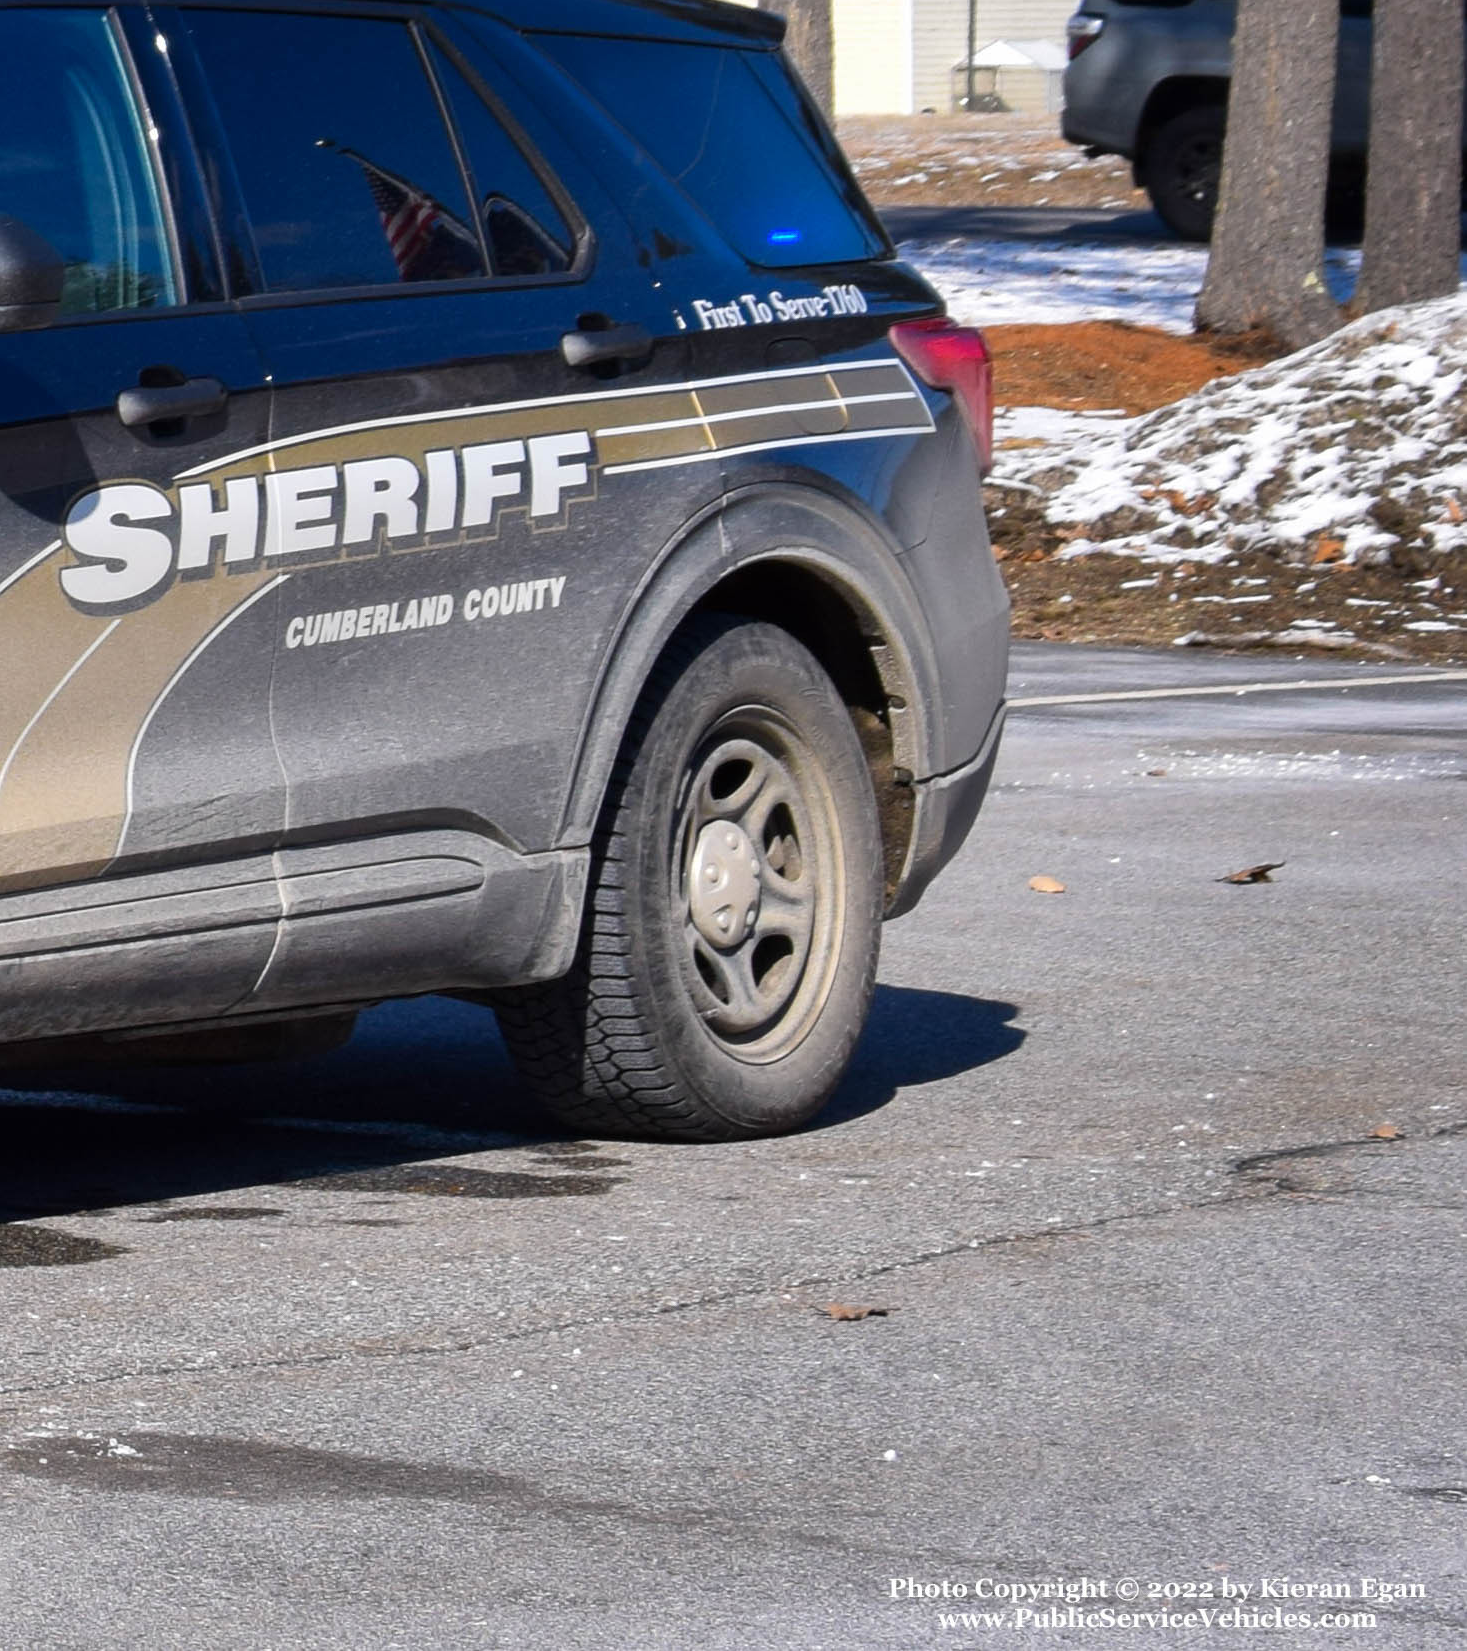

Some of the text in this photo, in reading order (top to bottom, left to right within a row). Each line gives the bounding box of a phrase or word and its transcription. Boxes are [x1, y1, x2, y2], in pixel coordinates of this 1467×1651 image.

[692, 284, 867, 331] First To Serve-1760
[59, 431, 591, 604] SHERIFF
[285, 576, 566, 648] CUMBERLAND COUNTY
